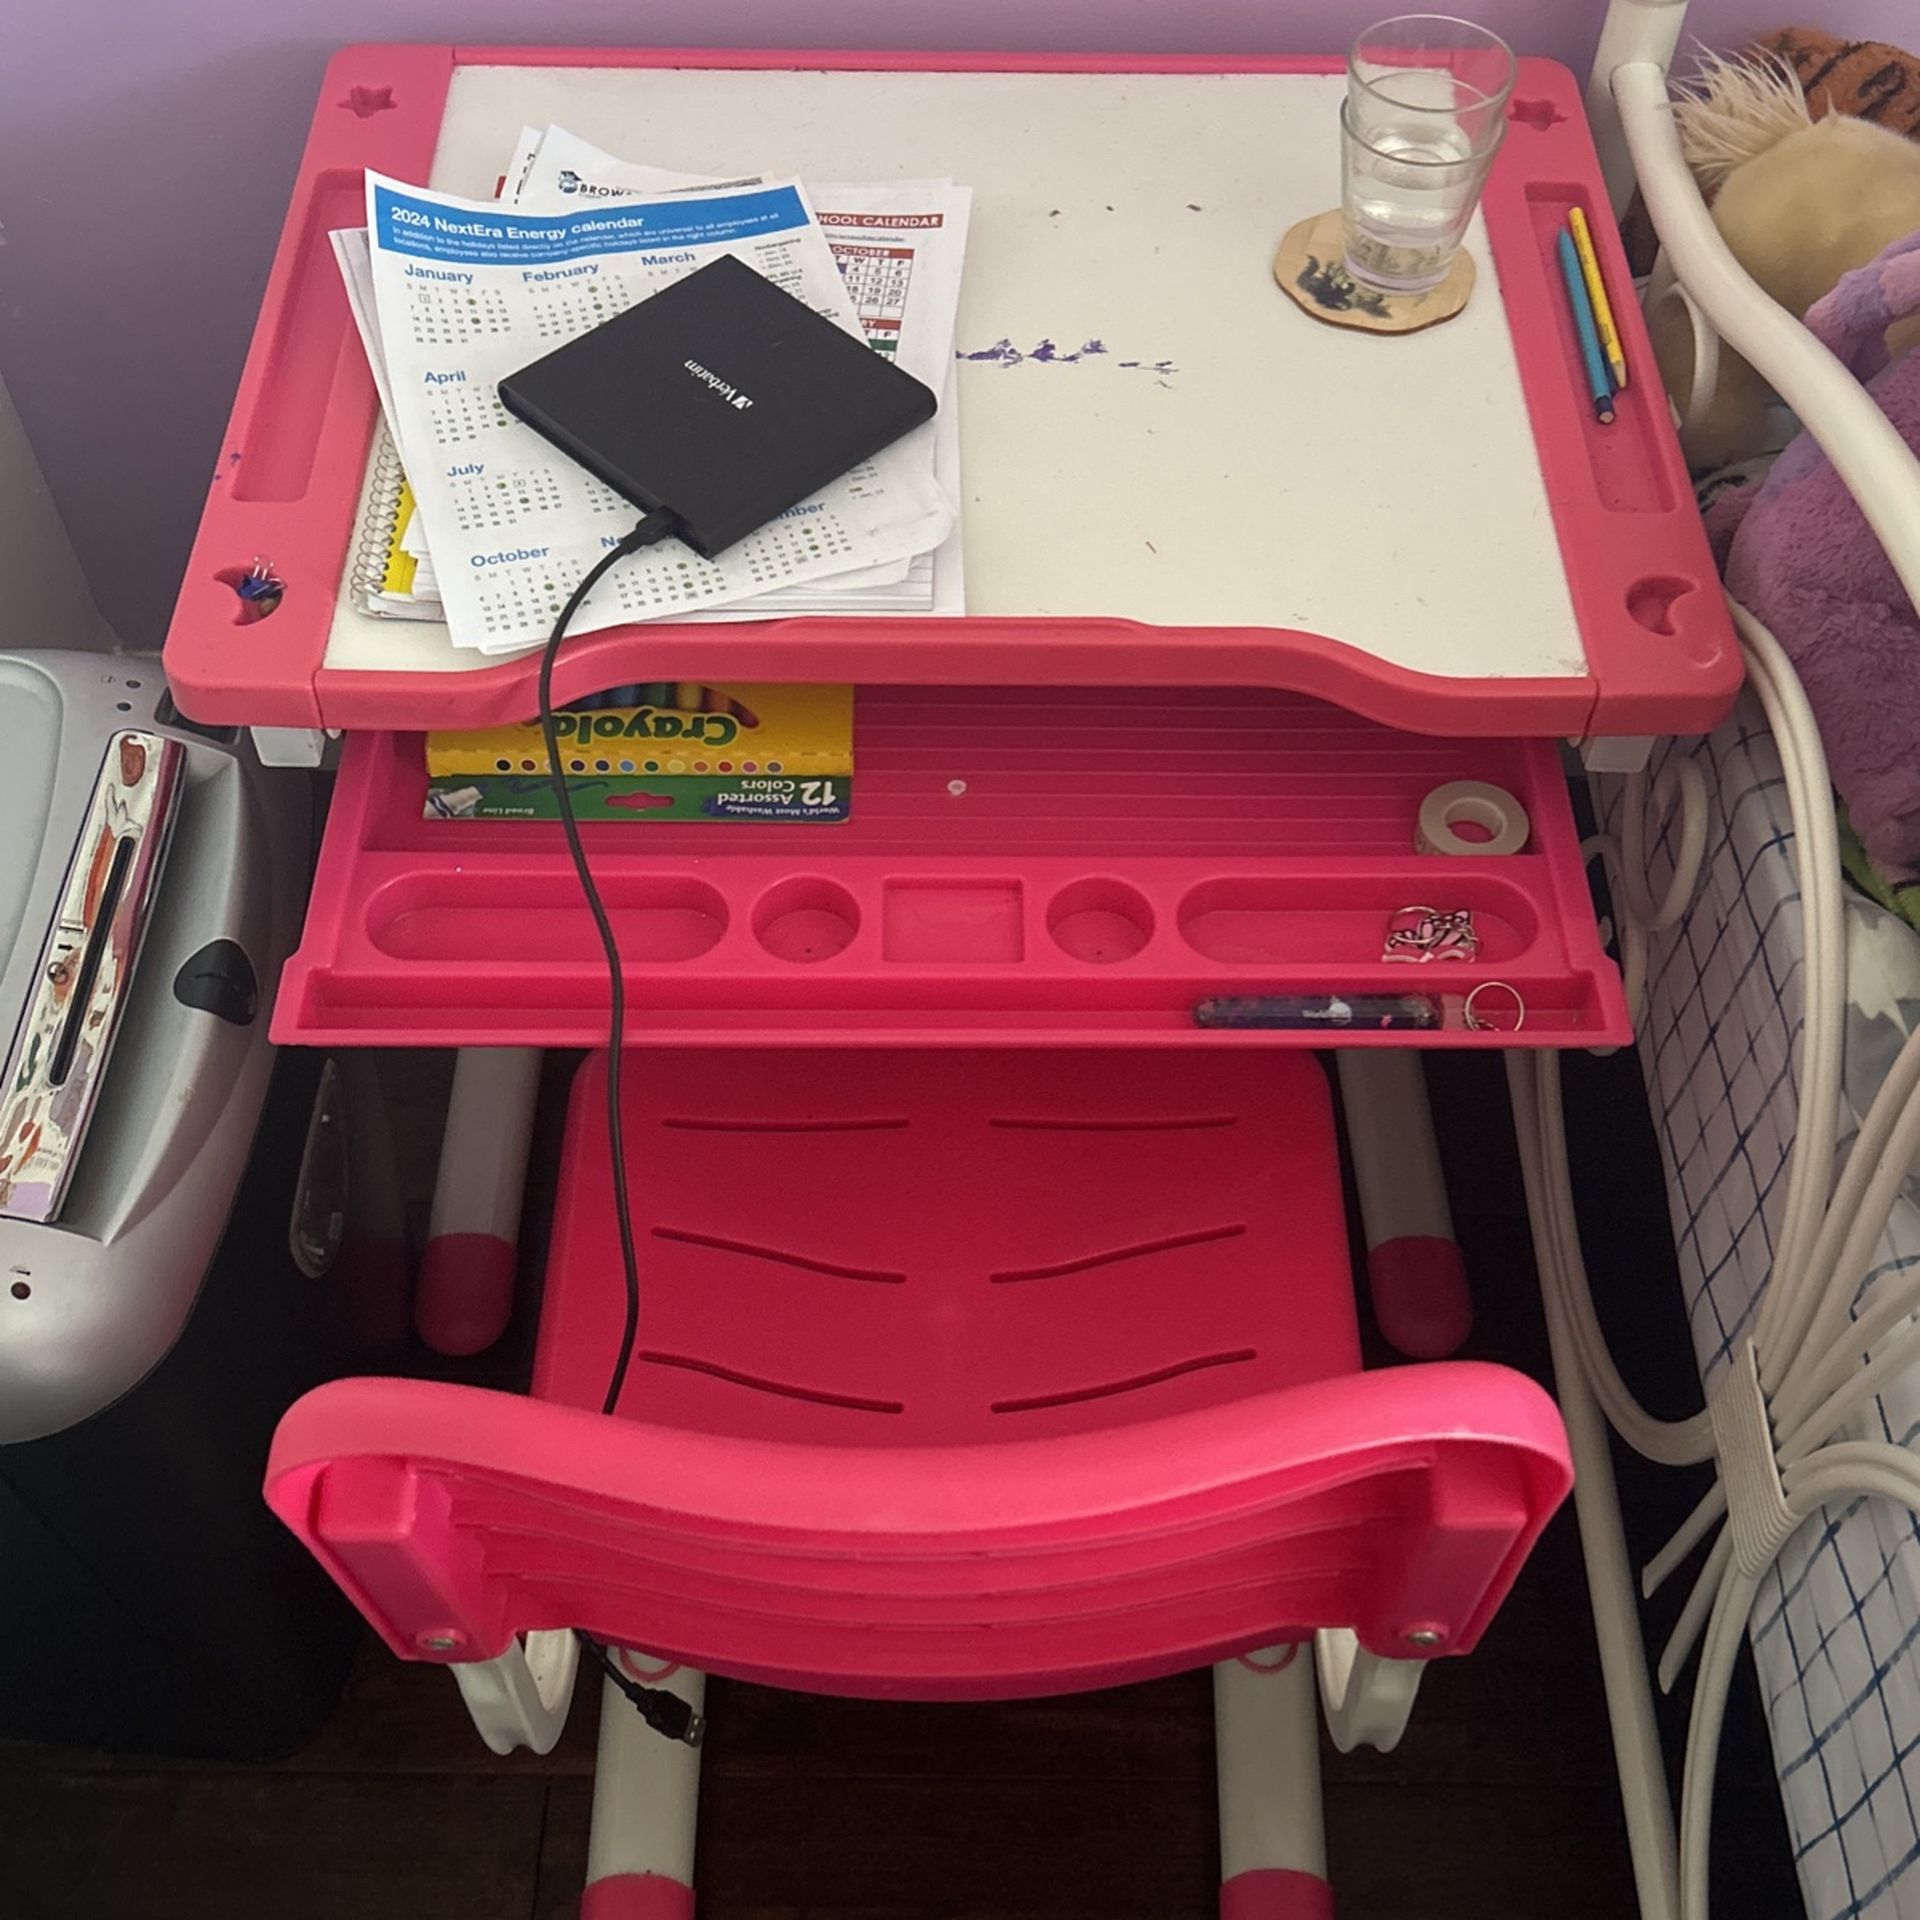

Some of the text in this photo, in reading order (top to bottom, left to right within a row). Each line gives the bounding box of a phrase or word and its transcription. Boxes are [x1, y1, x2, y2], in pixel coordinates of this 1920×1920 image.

[391, 206, 645, 241] 2024 NextEra Energy calendar
[818, 214, 939, 227] HOOL CALENDAR
[446, 237, 460, 246] the
[832, 246, 890, 257] OCTOBER
[641, 252, 696, 266] March
[405, 264, 473, 285] January
[523, 263, 599, 283] February
[891, 279, 903, 287] 13
[888, 288, 901, 297] 20
[886, 298, 900, 306] 27
[424, 370, 466, 385] April
[684, 360, 737, 401] Verbatim
[447, 464, 484, 477] July
[772, 502, 826, 520] mber
[471, 547, 549, 567] October
[551, 706, 738, 747] Crayola
[741, 780, 796, 793] Colors
[717, 781, 836, 806] 12 Assorted
[482, 807, 535, 816] Broad Line
[726, 805, 840, 816] World's Most Washable
